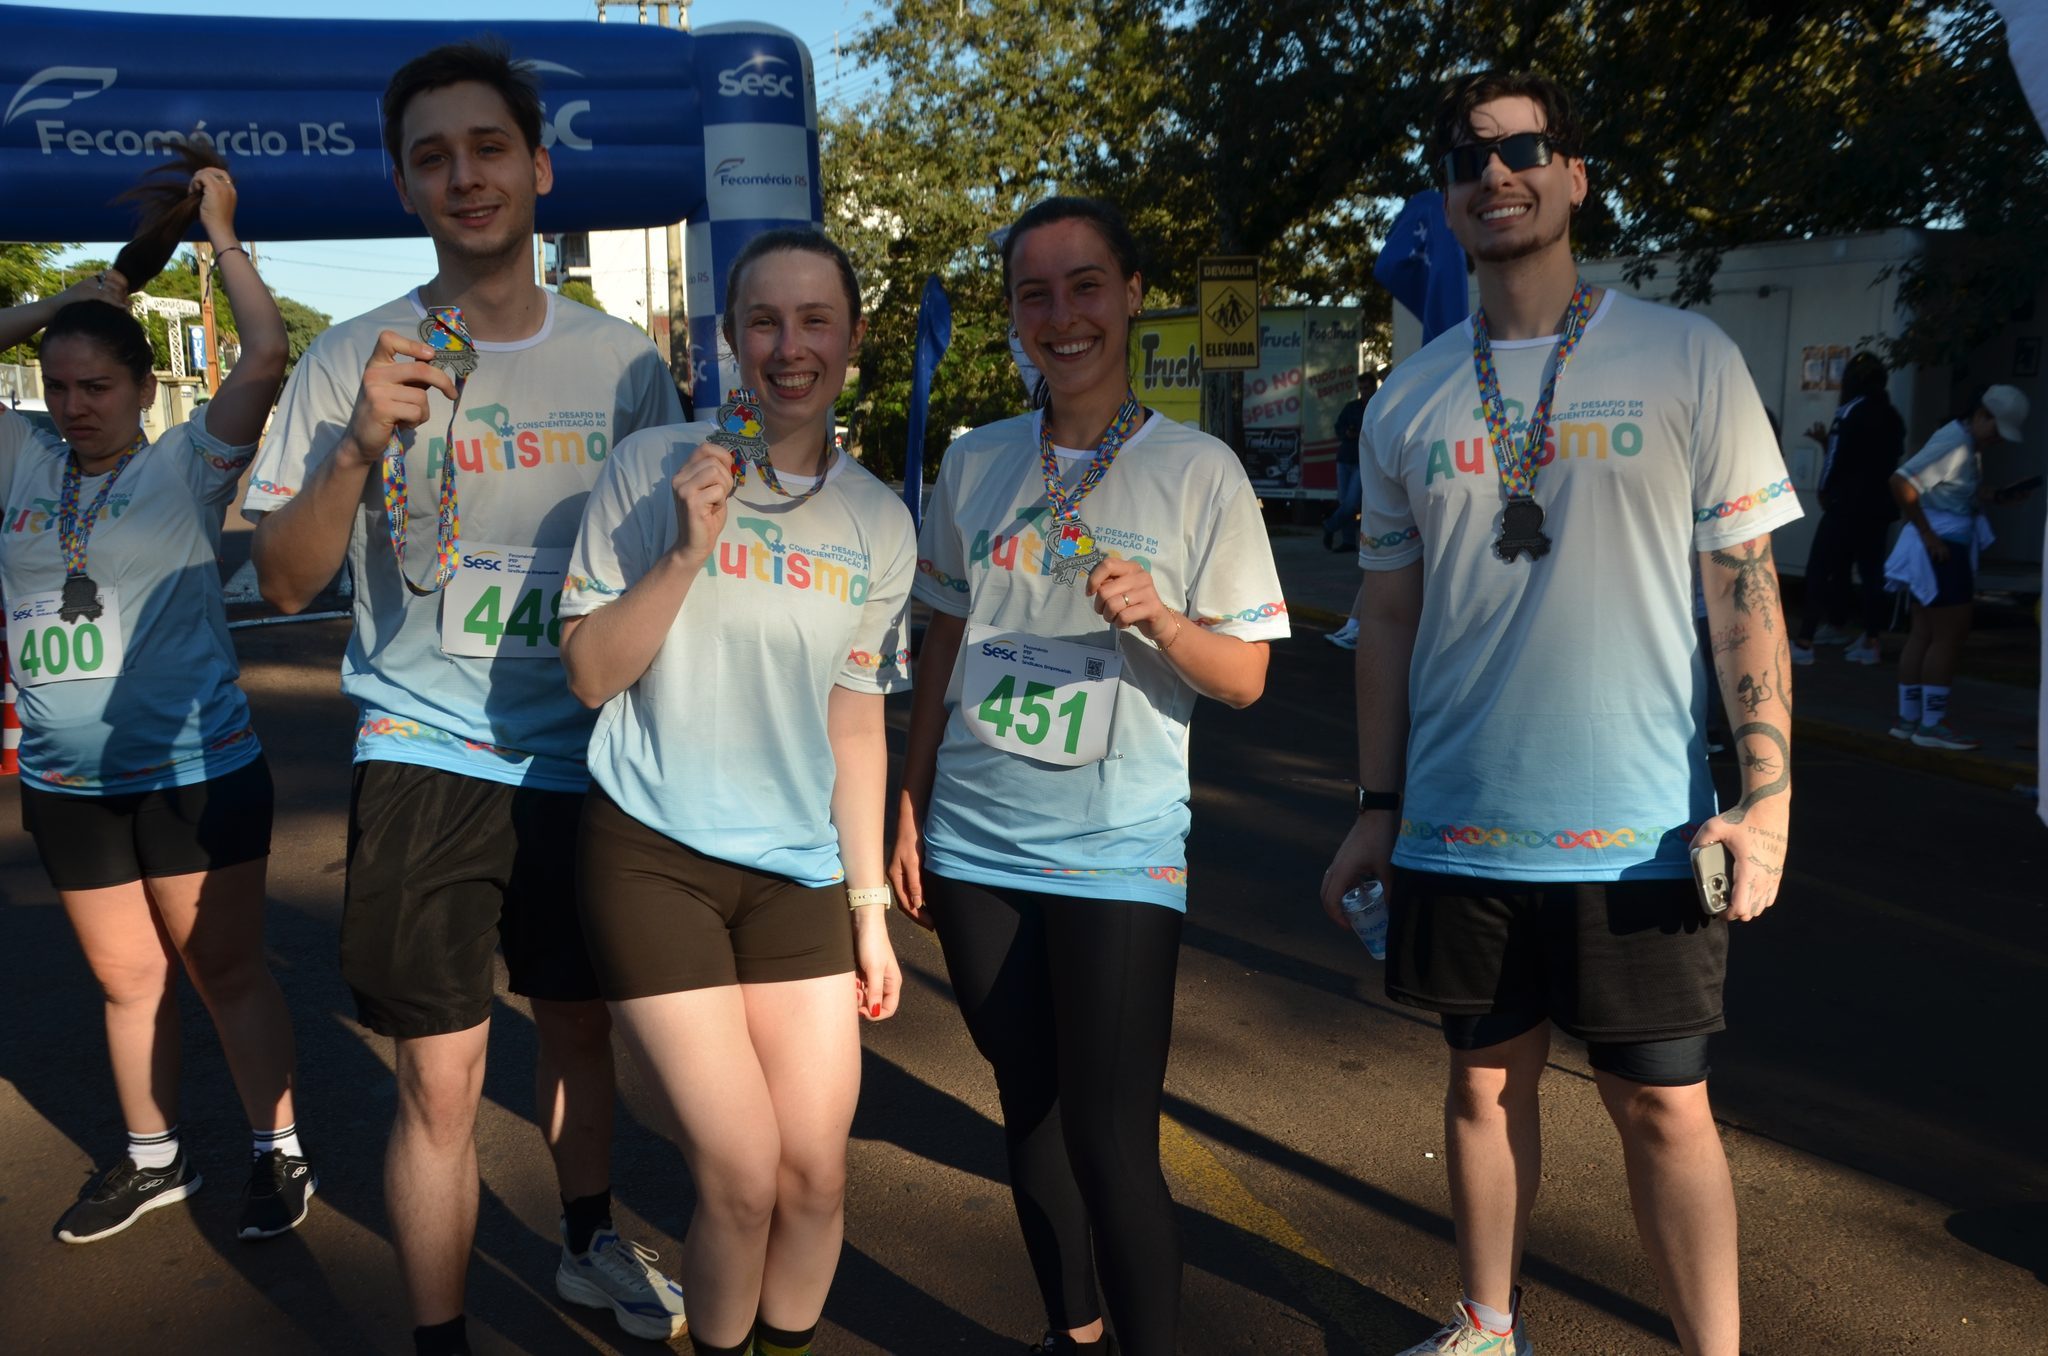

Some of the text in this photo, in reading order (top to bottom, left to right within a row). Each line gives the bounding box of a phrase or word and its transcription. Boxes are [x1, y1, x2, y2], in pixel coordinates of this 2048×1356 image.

[300, 122, 356, 157] RS
[721, 173, 808, 187] Fecomércio RS
[1203, 265, 1254, 277] DEVAGAR
[1260, 325, 1301, 349] Truck
[1205, 342, 1255, 357] ELEVADA
[1141, 333, 1201, 390] Truck
[1272, 368, 1302, 390] NO
[1628, 400, 1643, 409] EM
[559, 411, 594, 420] DESAFIO
[1629, 409, 1644, 418] AO
[516, 418, 607, 430] CONSCIENTIZAÇÃO AO
[1105, 528, 1144, 542] DESAFIO
[1146, 537, 1159, 547] EM
[789, 543, 861, 569] CONSCIENTIZAÇÃO
[831, 545, 863, 560] DESAFIO
[1144, 547, 1157, 555] AO
[20, 623, 104, 677] 400
[978, 674, 1088, 755] 451
